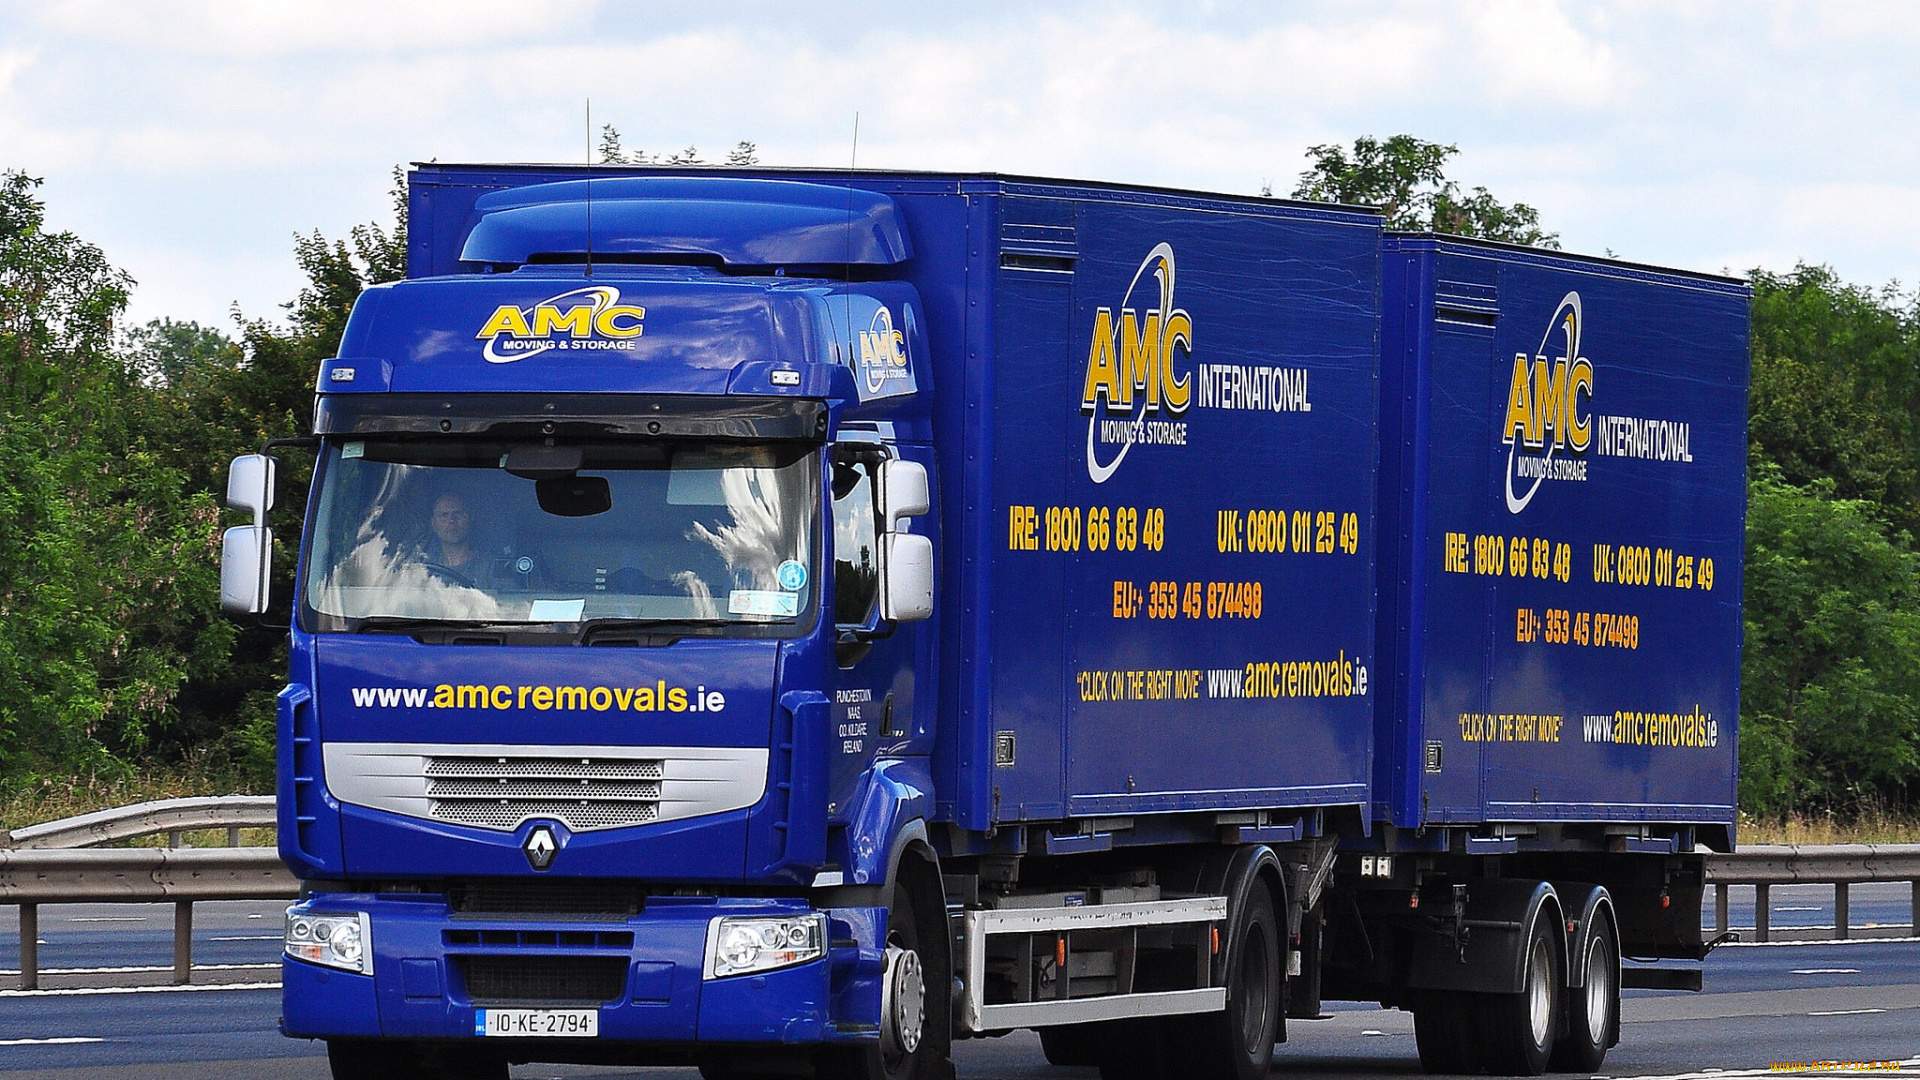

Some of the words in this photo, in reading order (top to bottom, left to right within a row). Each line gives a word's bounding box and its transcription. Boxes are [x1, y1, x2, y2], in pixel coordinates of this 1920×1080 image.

[475, 304, 646, 339] AMC
[503, 341, 555, 350] MOVING
[558, 341, 569, 350] &
[571, 341, 635, 350] STORAGE
[859, 329, 907, 367] AMC
[1081, 306, 1192, 414] AMC
[1198, 363, 1312, 412] INTERNATIONAL
[1502, 352, 1593, 452] AMC
[1101, 419, 1137, 444] MOVING
[1138, 421, 1145, 444] &
[1147, 421, 1187, 446] STORAGE
[1597, 414, 1693, 463] INTERNATIONAL
[1517, 456, 1546, 479] MOVING
[1547, 458, 1553, 480] &
[1554, 459, 1587, 482] STORAGE
[1009, 505, 1039, 550] IRE:
[1045, 506, 1081, 552] 1800
[1087, 506, 1110, 552] 66
[1116, 506, 1138, 552] 83
[1142, 508, 1165, 552] 48
[1217, 510, 1243, 553] UK:
[1247, 509, 1287, 553] 0800
[1292, 510, 1311, 553] 011
[1316, 510, 1335, 554] 25
[1339, 512, 1358, 555] 49
[1445, 532, 1469, 574] IRE:
[1474, 534, 1504, 576] 1800
[1510, 536, 1527, 577] 66
[1532, 538, 1549, 580] 83
[1553, 542, 1571, 584] 48
[1594, 543, 1615, 583] UK:
[1618, 545, 1651, 586] 0800
[1655, 547, 1673, 587] 011
[1675, 555, 1694, 589] 25
[1697, 557, 1714, 591] 49
[1148, 581, 1178, 619] 353
[1182, 582, 1202, 619] 45
[1207, 582, 1262, 619] 874498
[1545, 608, 1570, 644] 353
[1573, 612, 1590, 646] 45
[1594, 612, 1639, 650] 874498
[1111, 670, 1125, 701] ON
[1126, 670, 1144, 700] THE
[1146, 669, 1173, 700] RIGHT
[843, 739, 863, 754] IRELAND
[1486, 714, 1497, 742] ON
[1499, 714, 1514, 742] THE
[1515, 714, 1537, 742] RIGHT
[496, 1013, 588, 1032] 10-KE-2794
